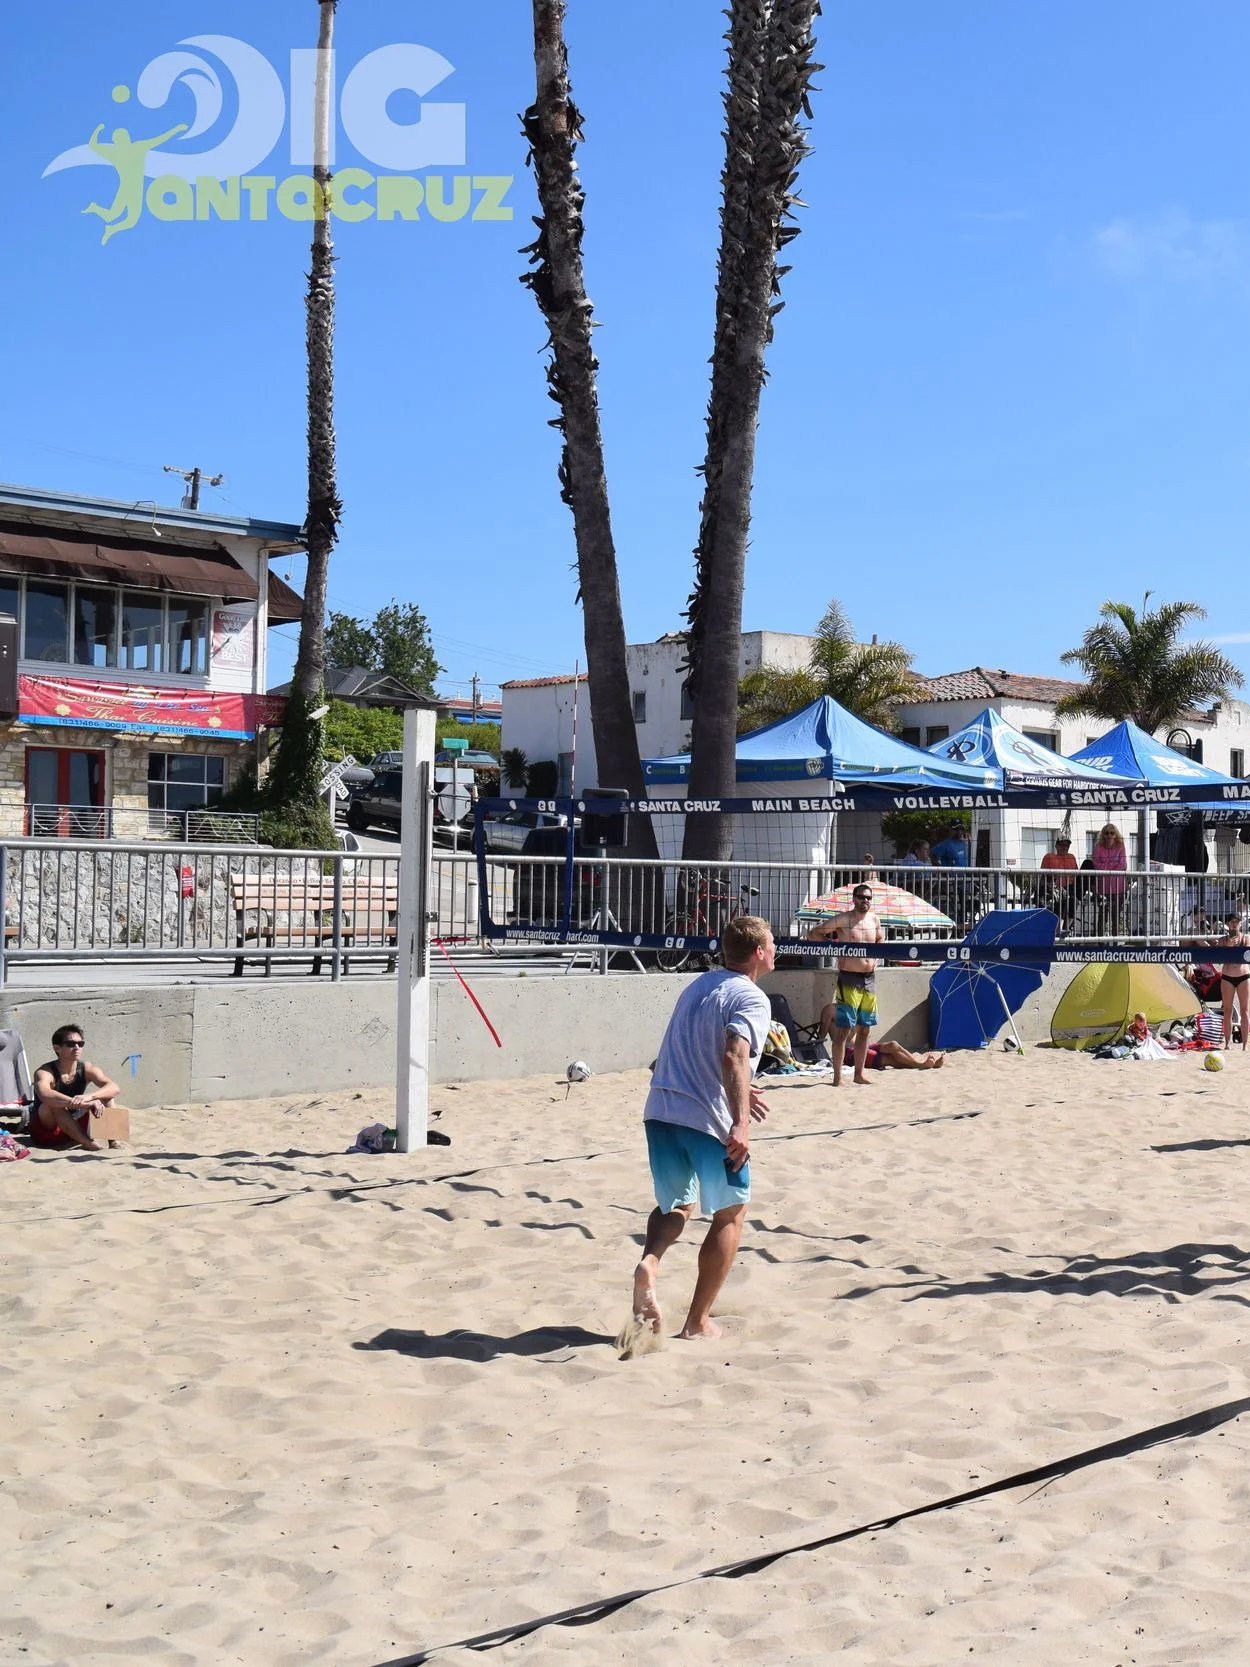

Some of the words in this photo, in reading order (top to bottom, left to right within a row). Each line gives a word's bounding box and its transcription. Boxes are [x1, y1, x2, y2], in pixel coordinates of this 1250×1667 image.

[83, 705, 129, 721] Thai
[133, 709, 199, 727] Cuisine
[1062, 780, 1073, 789] FOR
[639, 801, 682, 812] SANTA
[684, 800, 721, 812] CRUZ
[752, 800, 792, 811] MAIN
[799, 798, 856, 811] BEACH
[893, 794, 1009, 809] VOLLEYBALL
[1071, 790, 1128, 804] SANTA
[1131, 788, 1181, 802] CRUZ
[506, 928, 599, 943] www.santacruzharf.com
[1056, 949, 1192, 963] www.santacruzwharf.com
